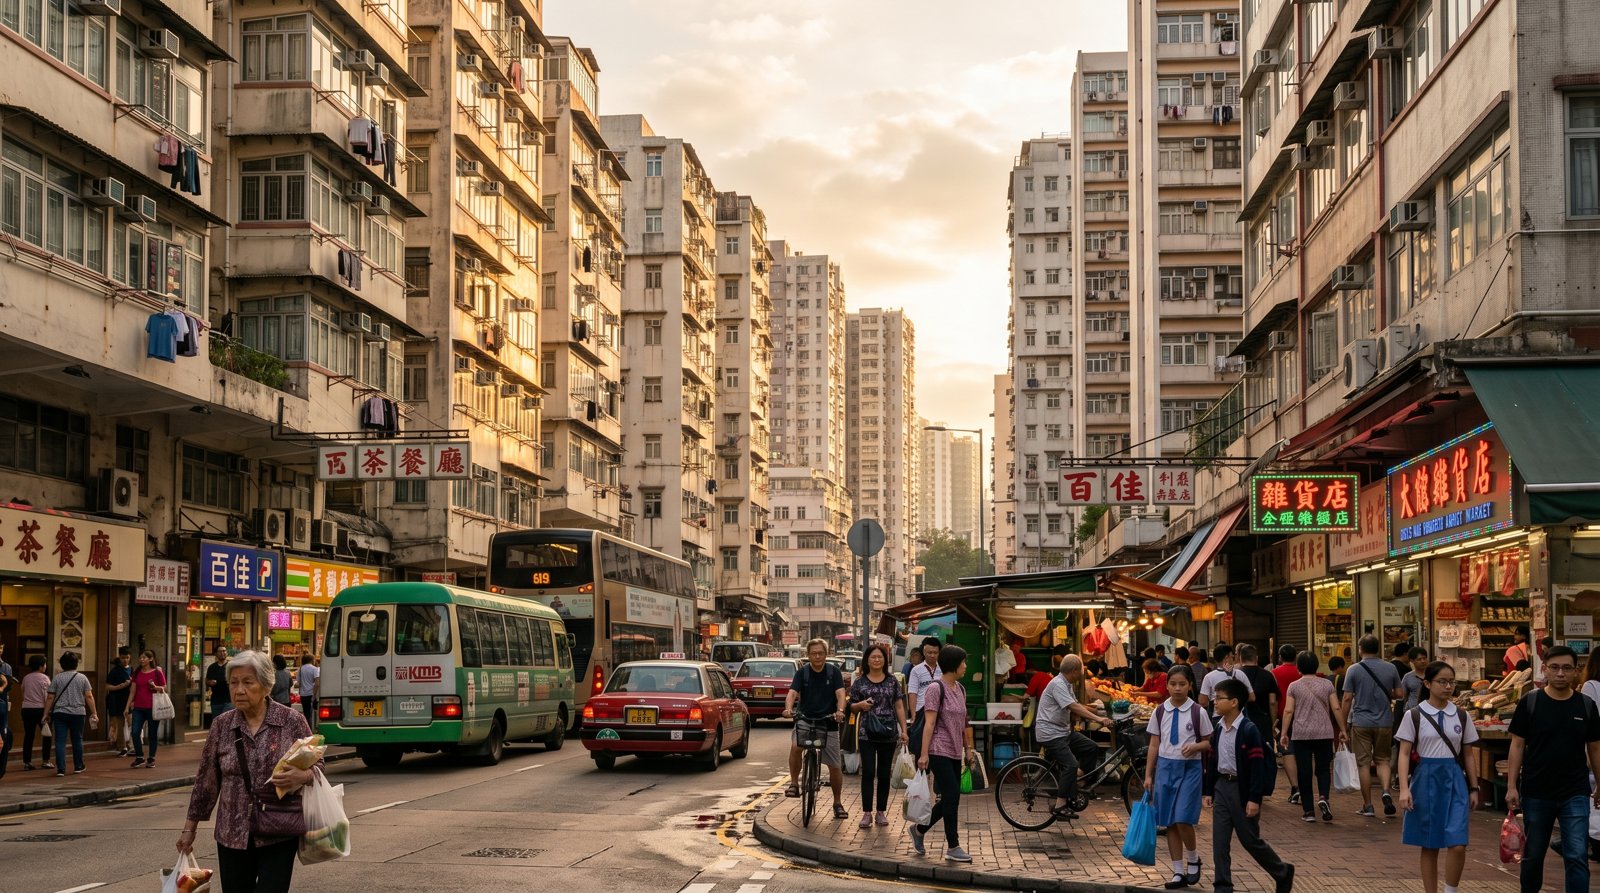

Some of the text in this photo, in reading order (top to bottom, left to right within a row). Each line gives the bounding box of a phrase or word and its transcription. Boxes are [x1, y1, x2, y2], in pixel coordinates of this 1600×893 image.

[1063, 469, 1145, 502] 百佳
[1261, 480, 1349, 510] 雜貨店
[0, 518, 113, 572] 茶餐廳
[210, 552, 251, 589] 百佳
[532, 572, 551, 585] 619
[408, 666, 442, 680] KMB
[358, 708, 377, 716] 834
